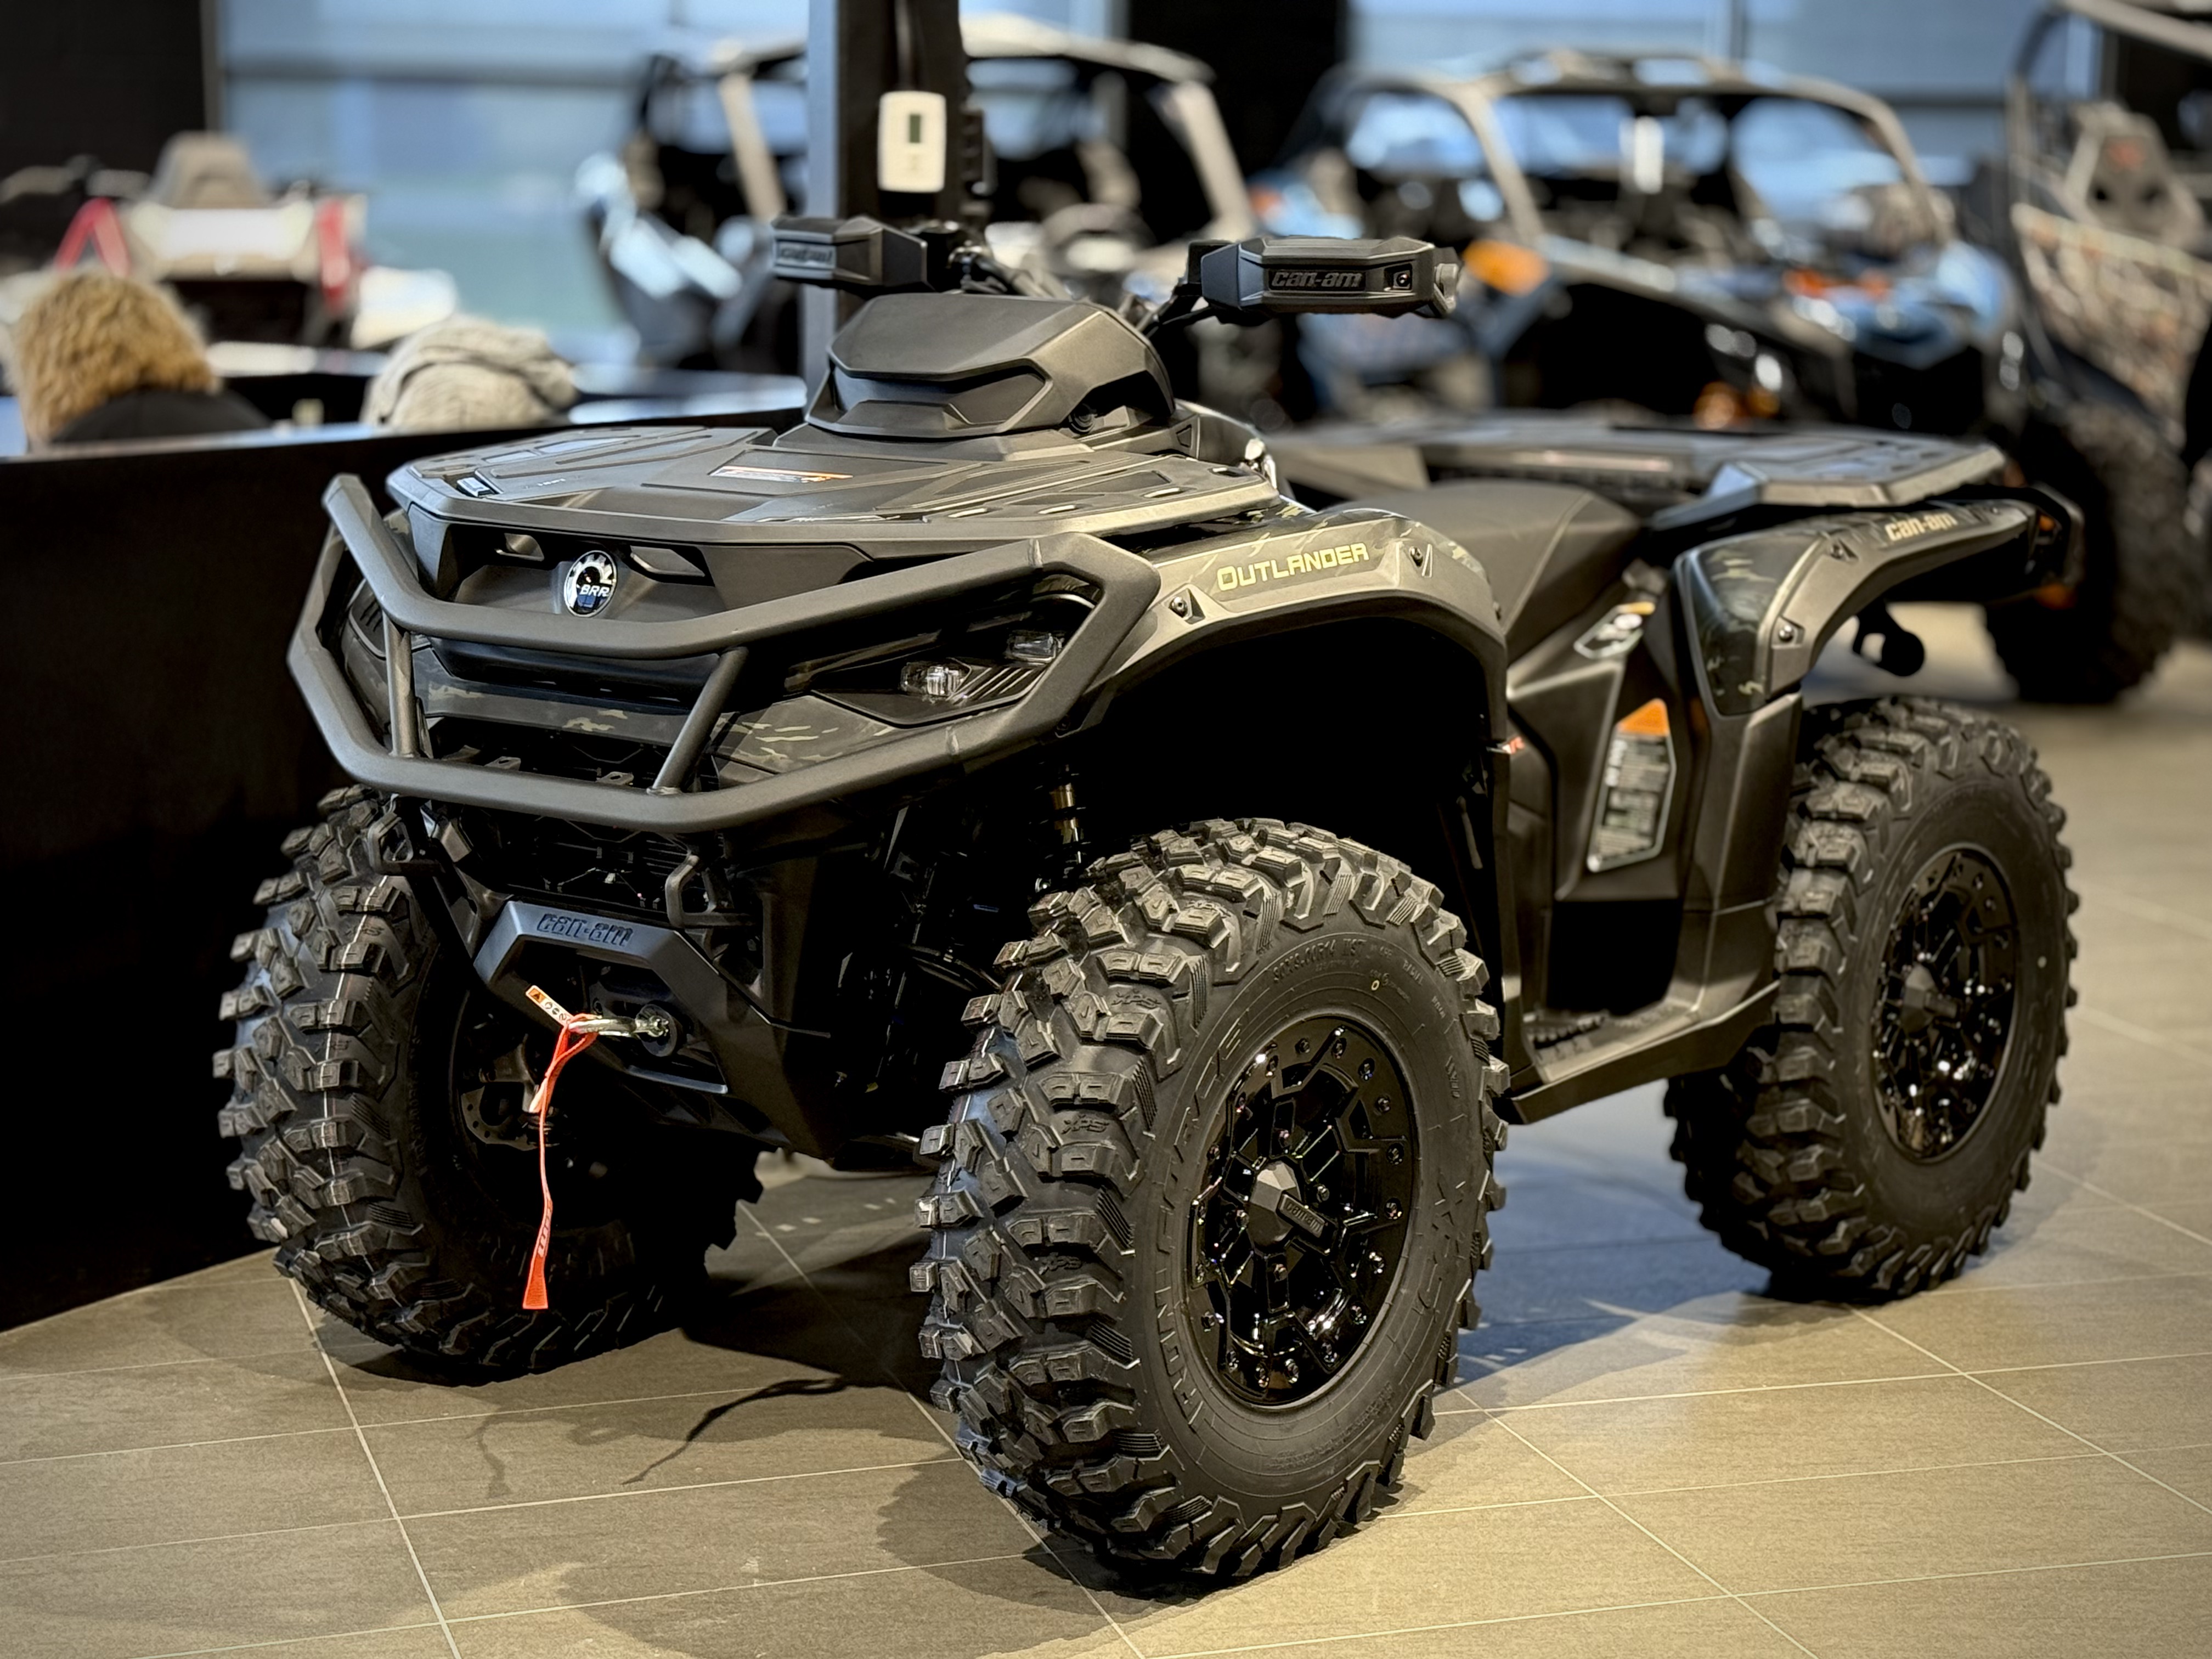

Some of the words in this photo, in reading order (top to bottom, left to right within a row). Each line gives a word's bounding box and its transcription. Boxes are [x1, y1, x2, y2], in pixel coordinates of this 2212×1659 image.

[1271, 270, 1363, 289] can-am
[1884, 512, 1958, 541] can-am
[1216, 542, 1369, 591] OUTLANDER
[537, 912, 634, 947] can-am
